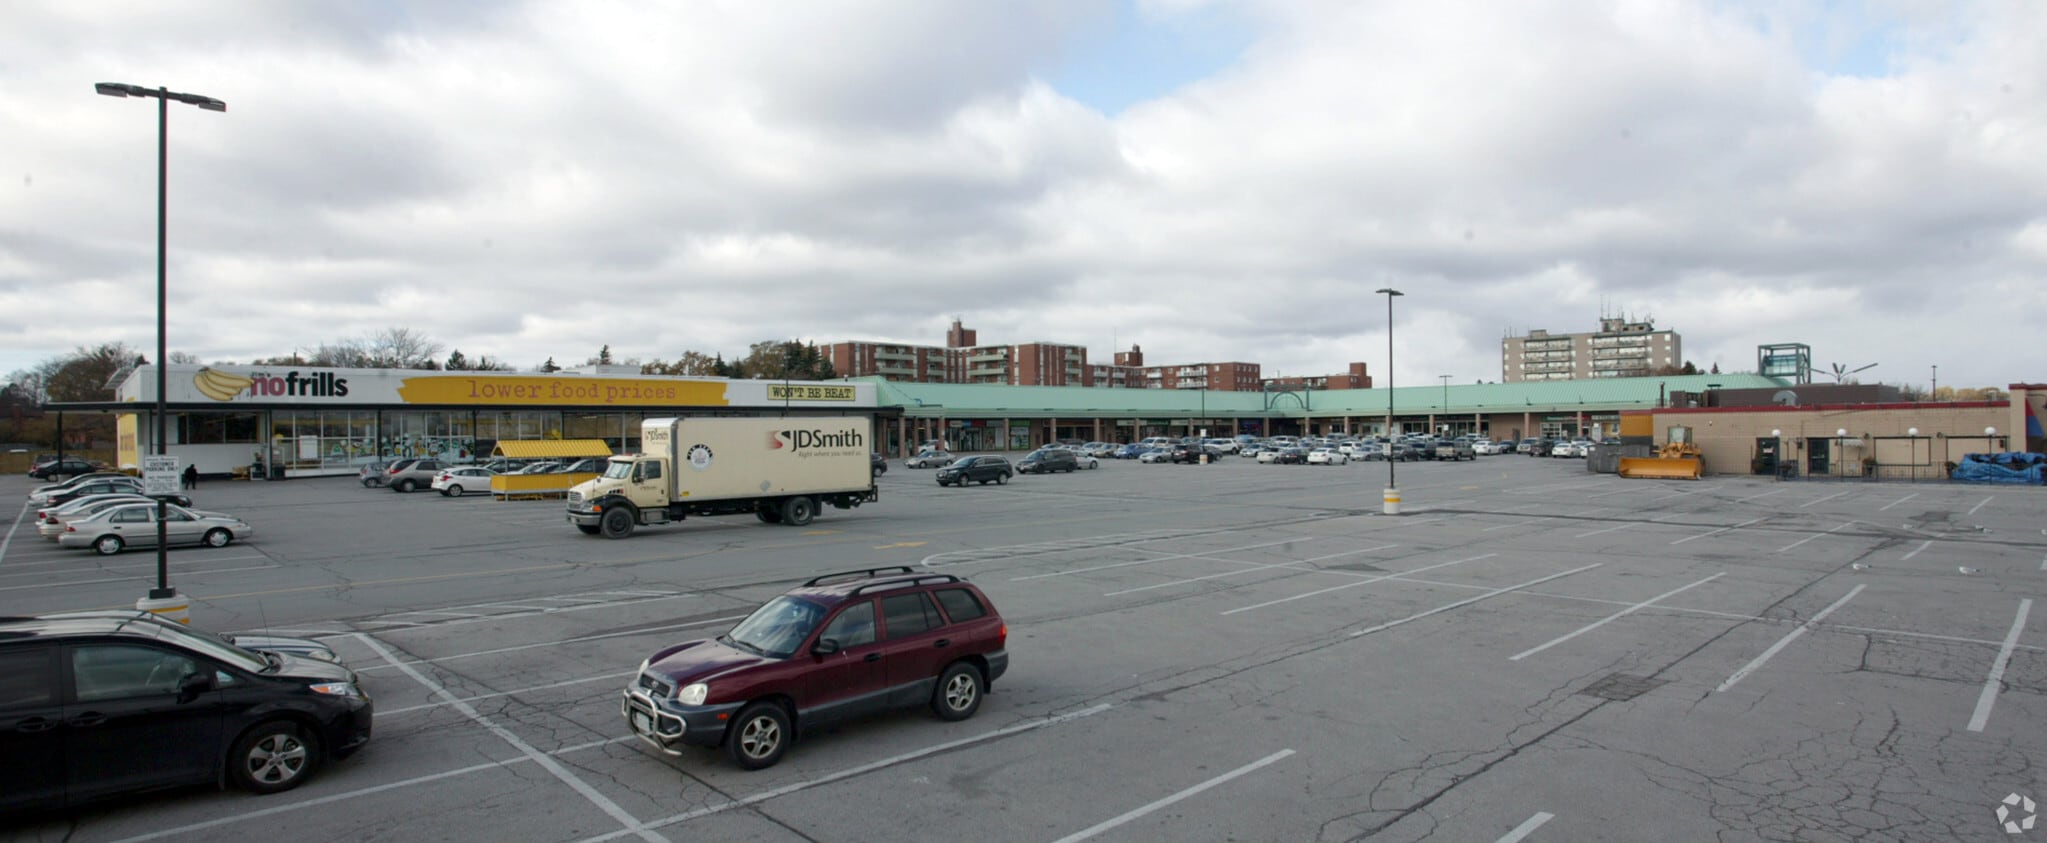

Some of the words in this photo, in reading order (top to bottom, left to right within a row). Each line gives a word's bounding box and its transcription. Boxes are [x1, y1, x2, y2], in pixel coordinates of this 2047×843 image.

[468, 380, 542, 399] lower
[550, 381, 599, 399] food
[606, 382, 676, 402] prices
[772, 386, 804, 398] WON'T
[807, 387, 821, 398] BE
[824, 388, 851, 399] BEAT
[791, 428, 863, 452] JDSmith
